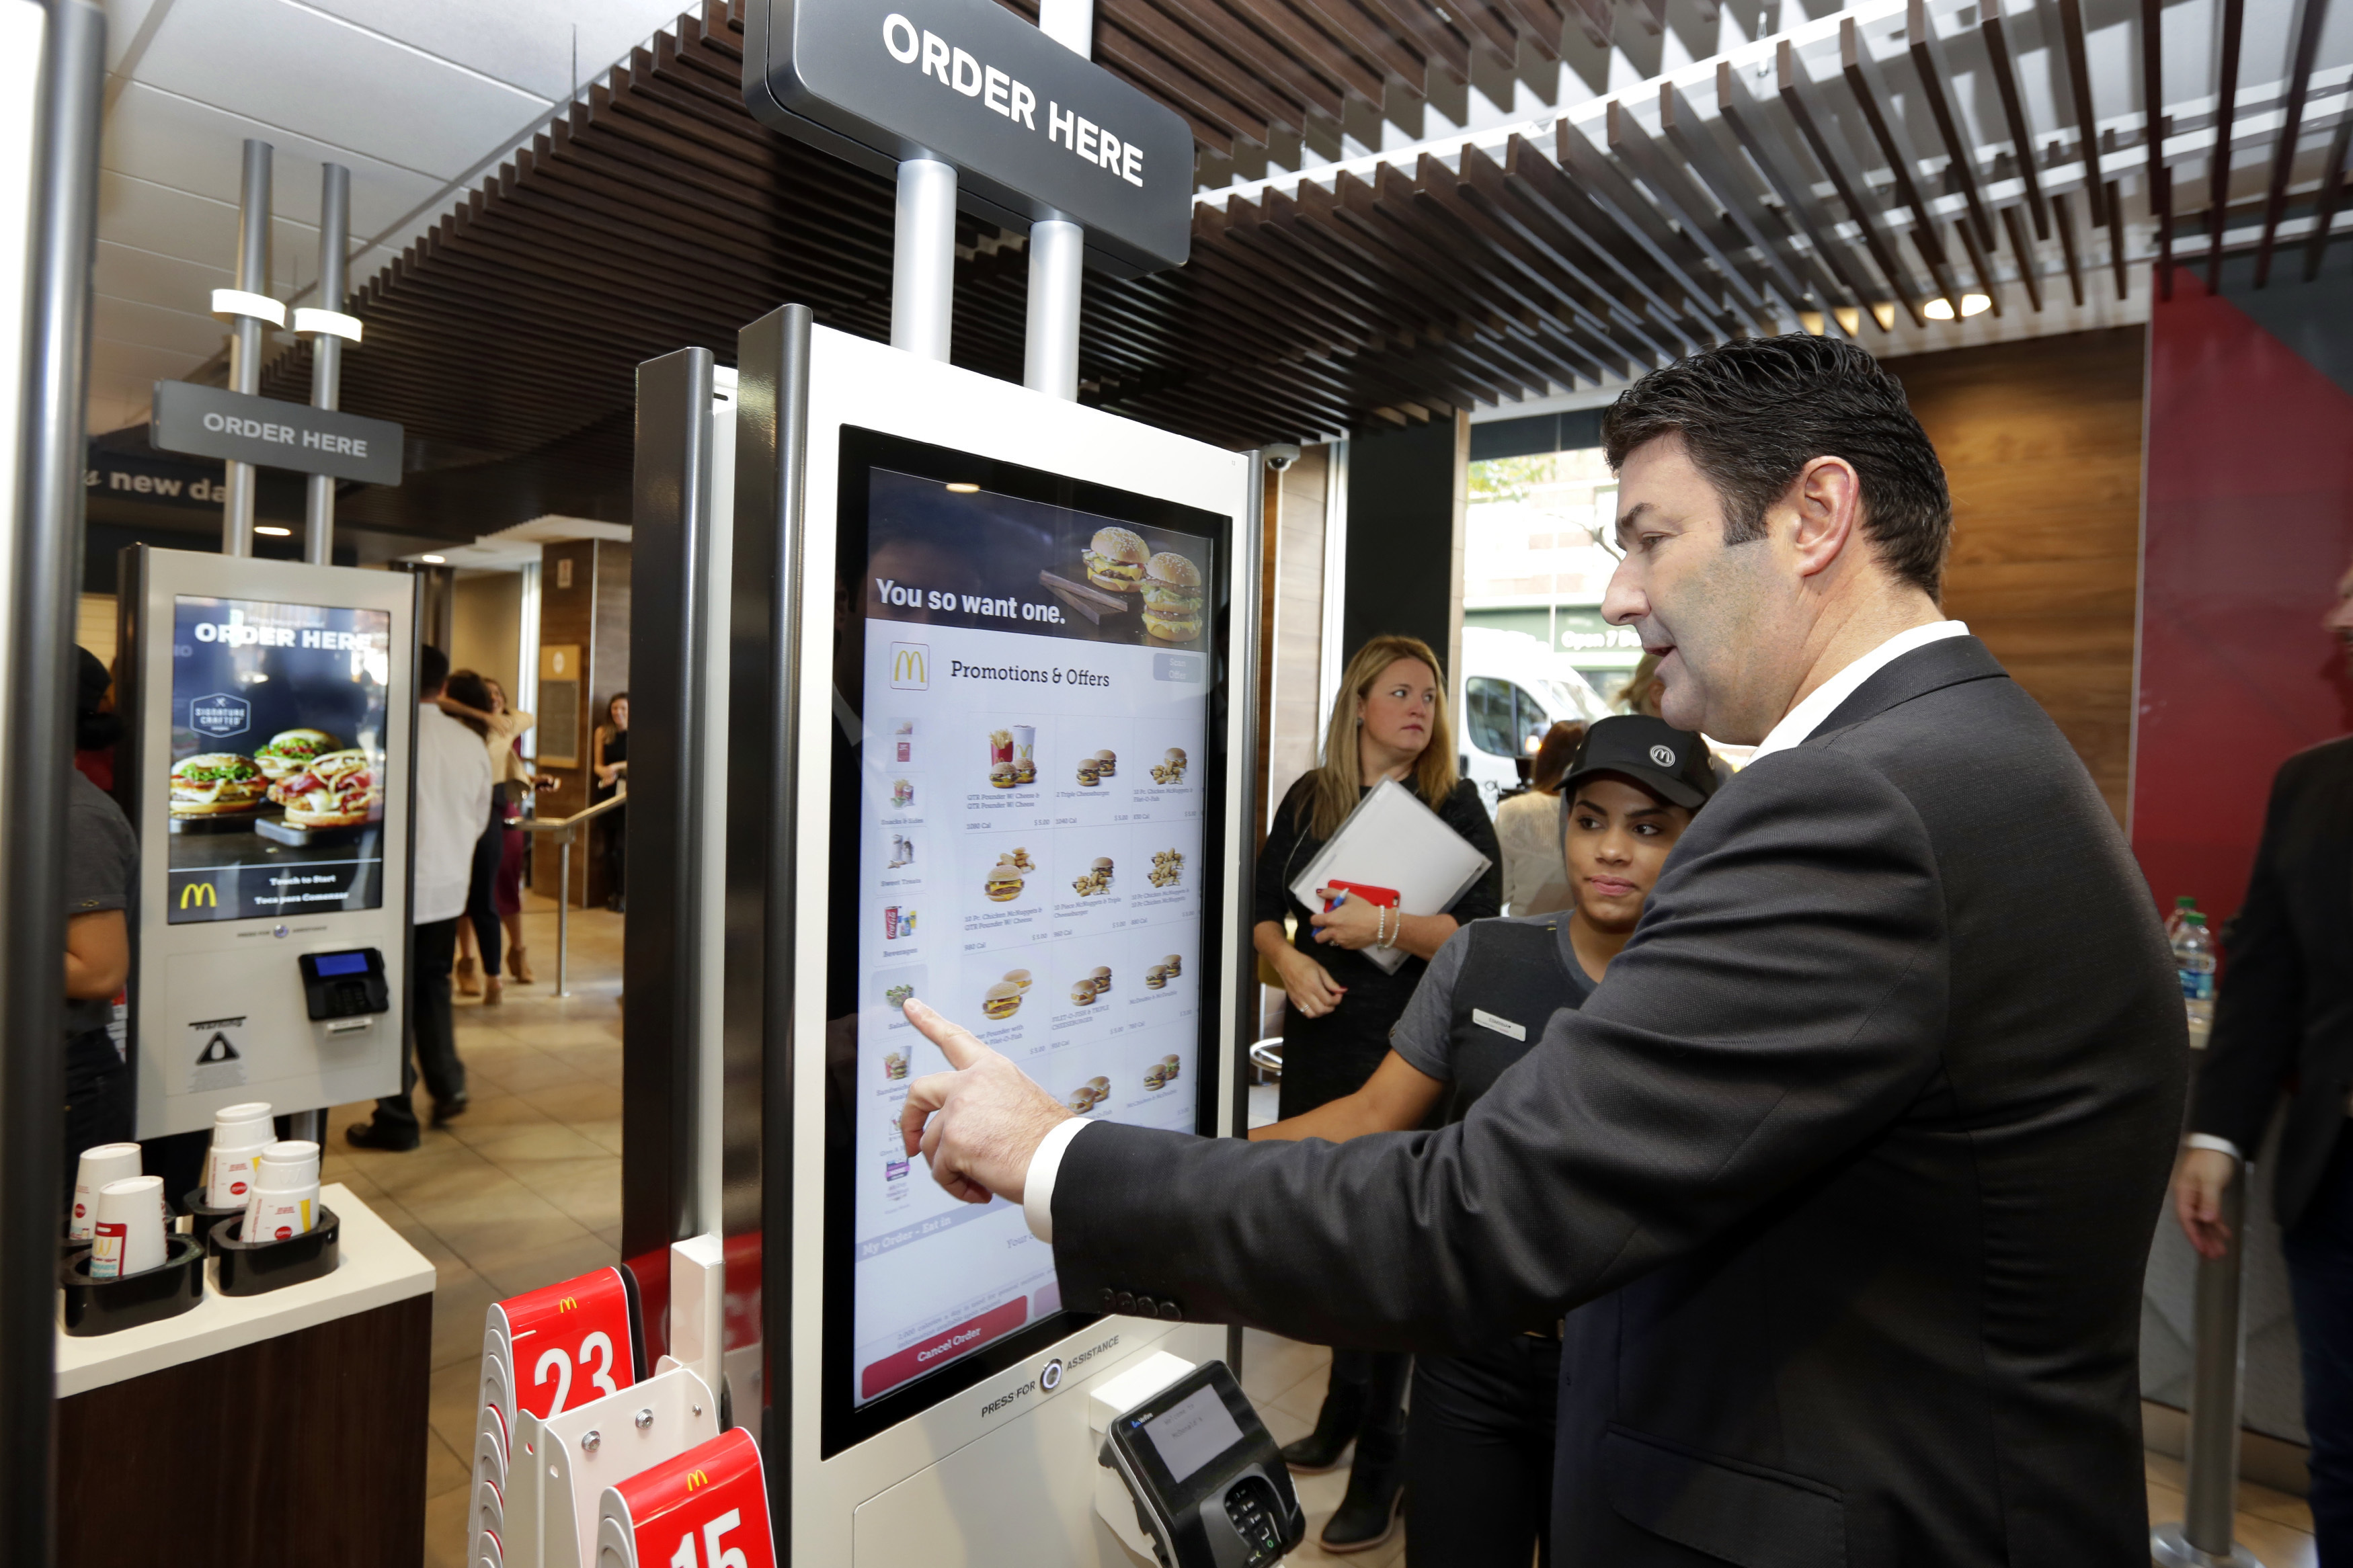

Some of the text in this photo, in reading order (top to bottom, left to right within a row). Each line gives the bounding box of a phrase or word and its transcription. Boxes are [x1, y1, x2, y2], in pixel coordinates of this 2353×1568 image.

[883, 13, 1143, 188] ORDER HERE
[203, 411, 368, 458] ORDER HERE
[110, 471, 183, 497] new
[189, 478, 227, 503] da
[876, 578, 1066, 624] You so want one.
[195, 622, 296, 647] ORDER
[1561, 630, 1642, 651] Open 7 Da
[951, 660, 1109, 687] Promotions & Offers
[1170, 658, 1186, 667] Scan
[269, 874, 336, 886] Touch to Start
[1007, 909, 1037, 917] McNuggets
[883, 948, 918, 958] Beverages
[863, 1242, 880, 1255] My
[882, 1231, 913, 1247] Order
[922, 1219, 939, 1234] Eat
[917, 1327, 982, 1363] Cancel Order
[534, 1331, 617, 1419] 23
[982, 1335, 1119, 1417] PRESS FOR ASSISTANCE
